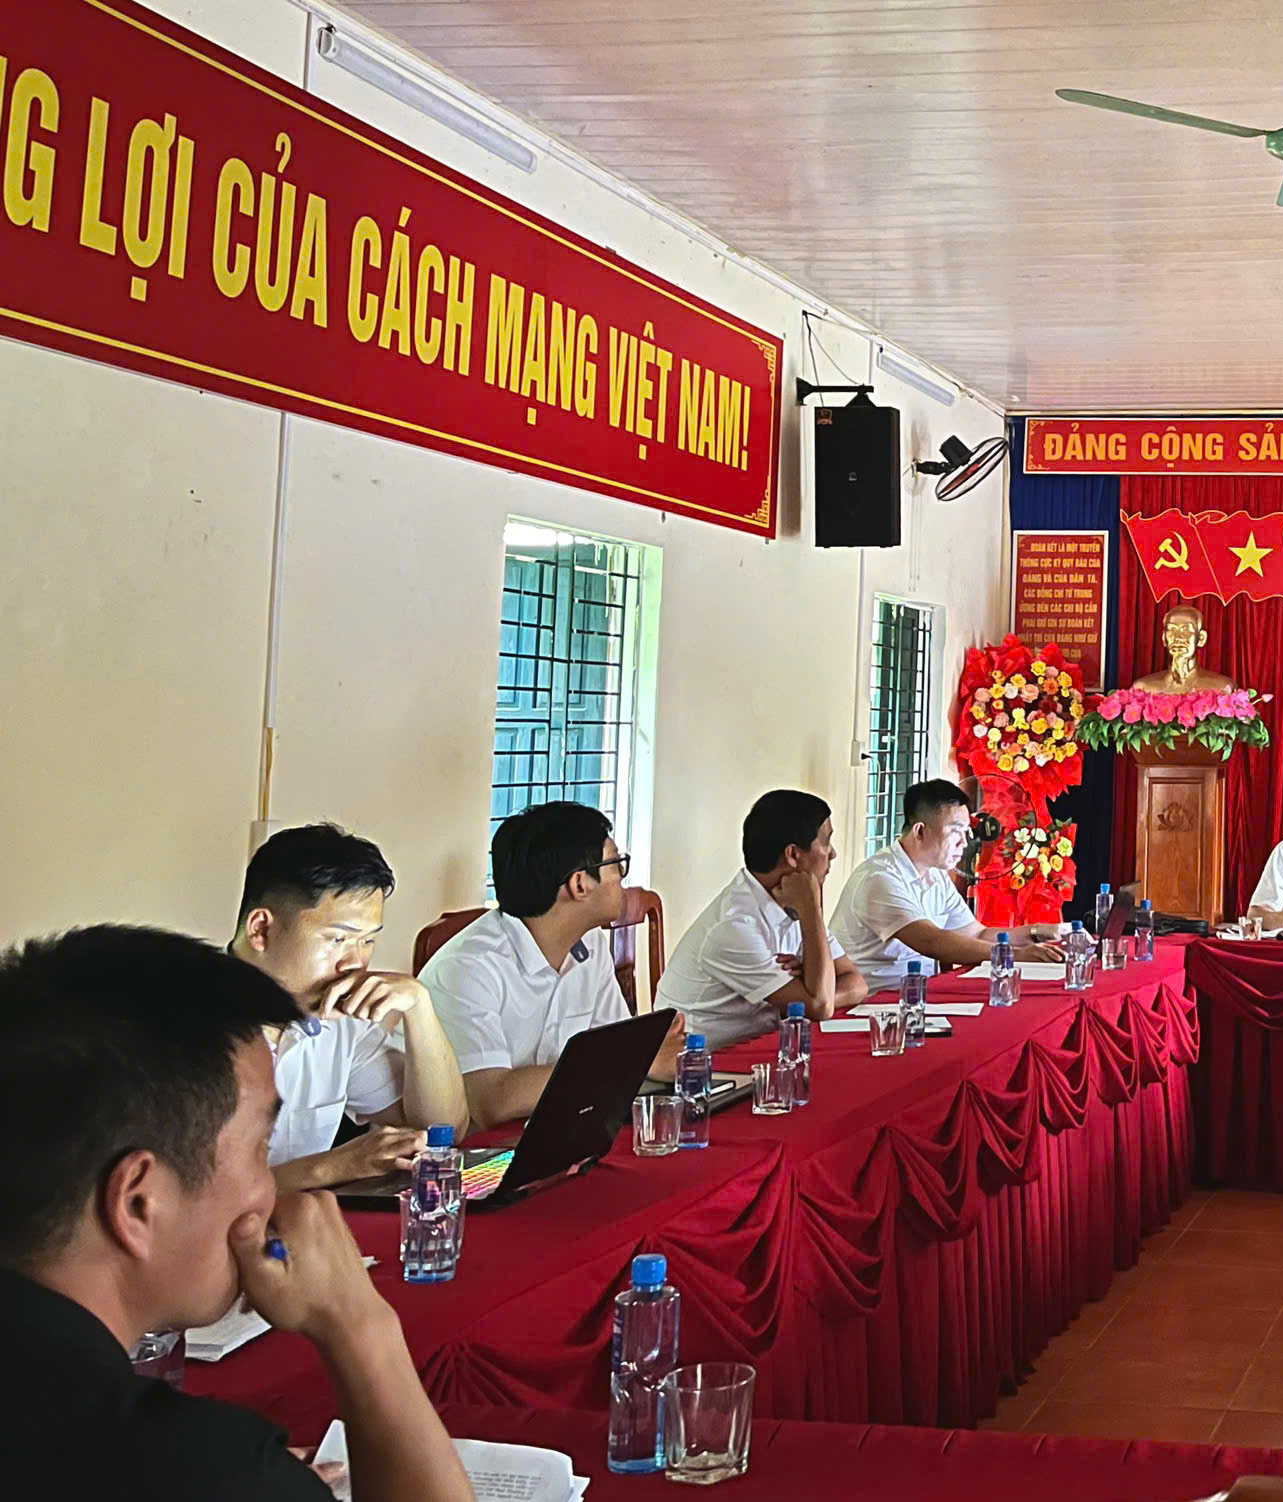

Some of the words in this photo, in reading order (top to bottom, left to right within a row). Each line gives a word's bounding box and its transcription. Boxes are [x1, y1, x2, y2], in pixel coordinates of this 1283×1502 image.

[79, 97, 195, 301] LỢI
[213, 133, 328, 330] CỦA
[347, 206, 473, 376] CÁCH
[485, 273, 598, 426] MẠNG
[609, 321, 672, 461] VIỆT
[677, 358, 751, 471] NAM!
[1044, 423, 1127, 462] ĐẢNG
[1141, 425, 1224, 468] CỘNG
